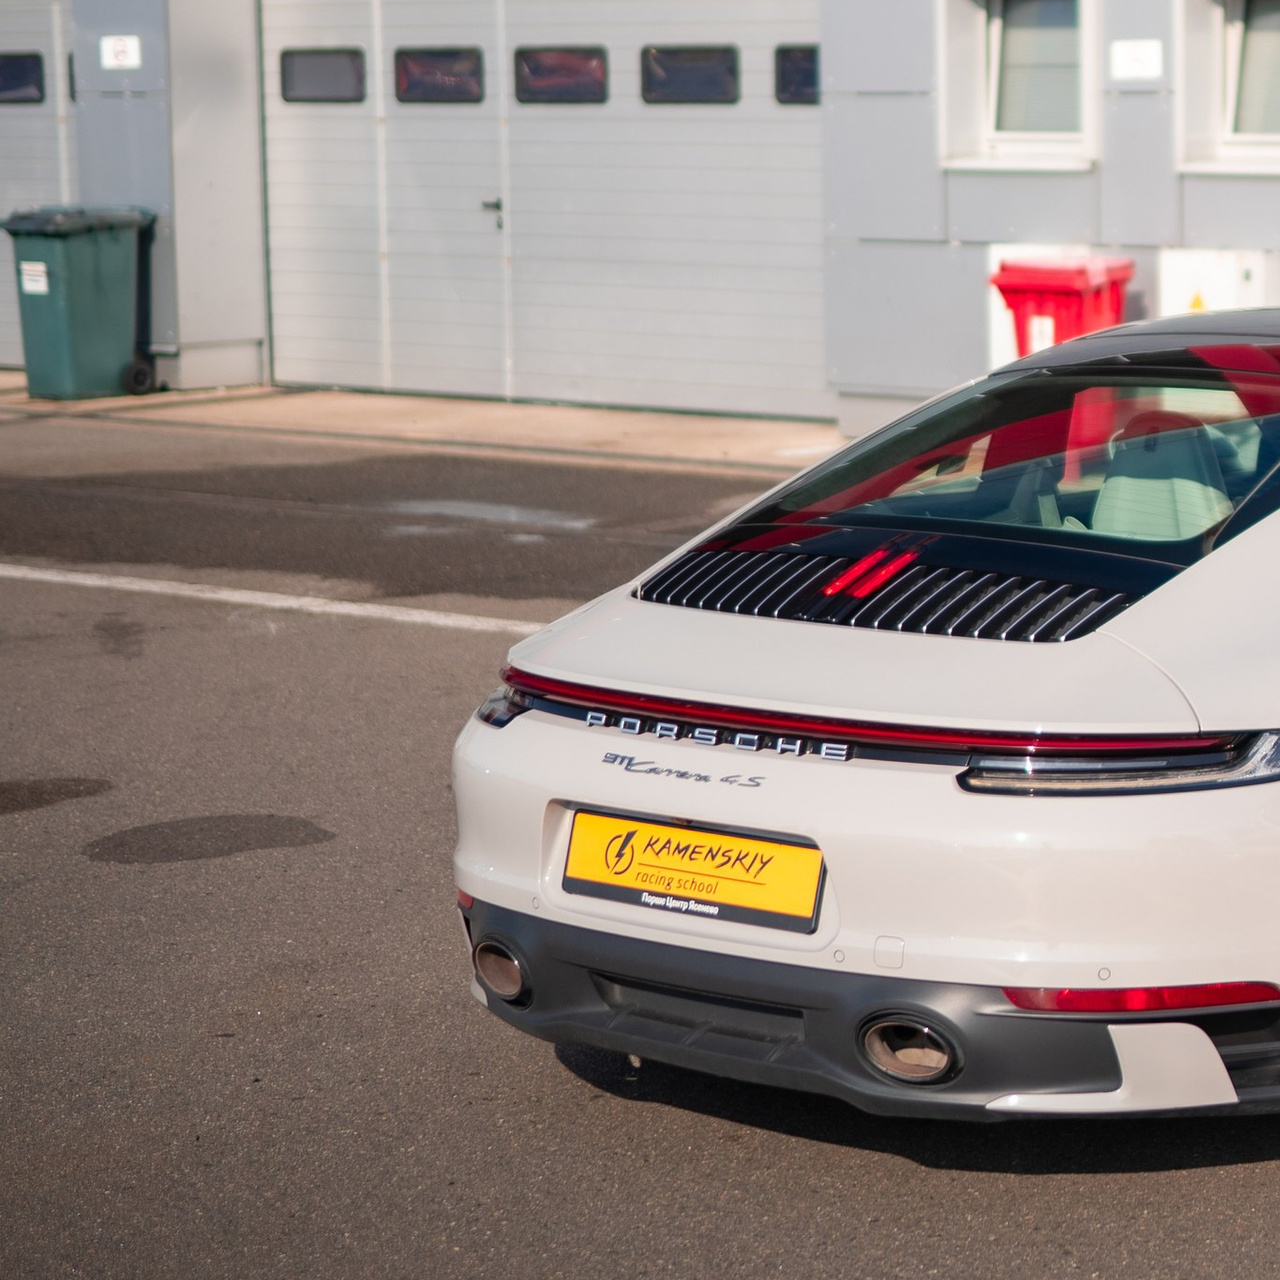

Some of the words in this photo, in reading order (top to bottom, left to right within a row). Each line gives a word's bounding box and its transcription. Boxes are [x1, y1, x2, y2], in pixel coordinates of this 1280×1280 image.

[586, 711, 850, 761] PORSCHE
[643, 835, 774, 879] KAMENSKIY
[635, 870, 673, 891] racing
[676, 877, 719, 895] school
